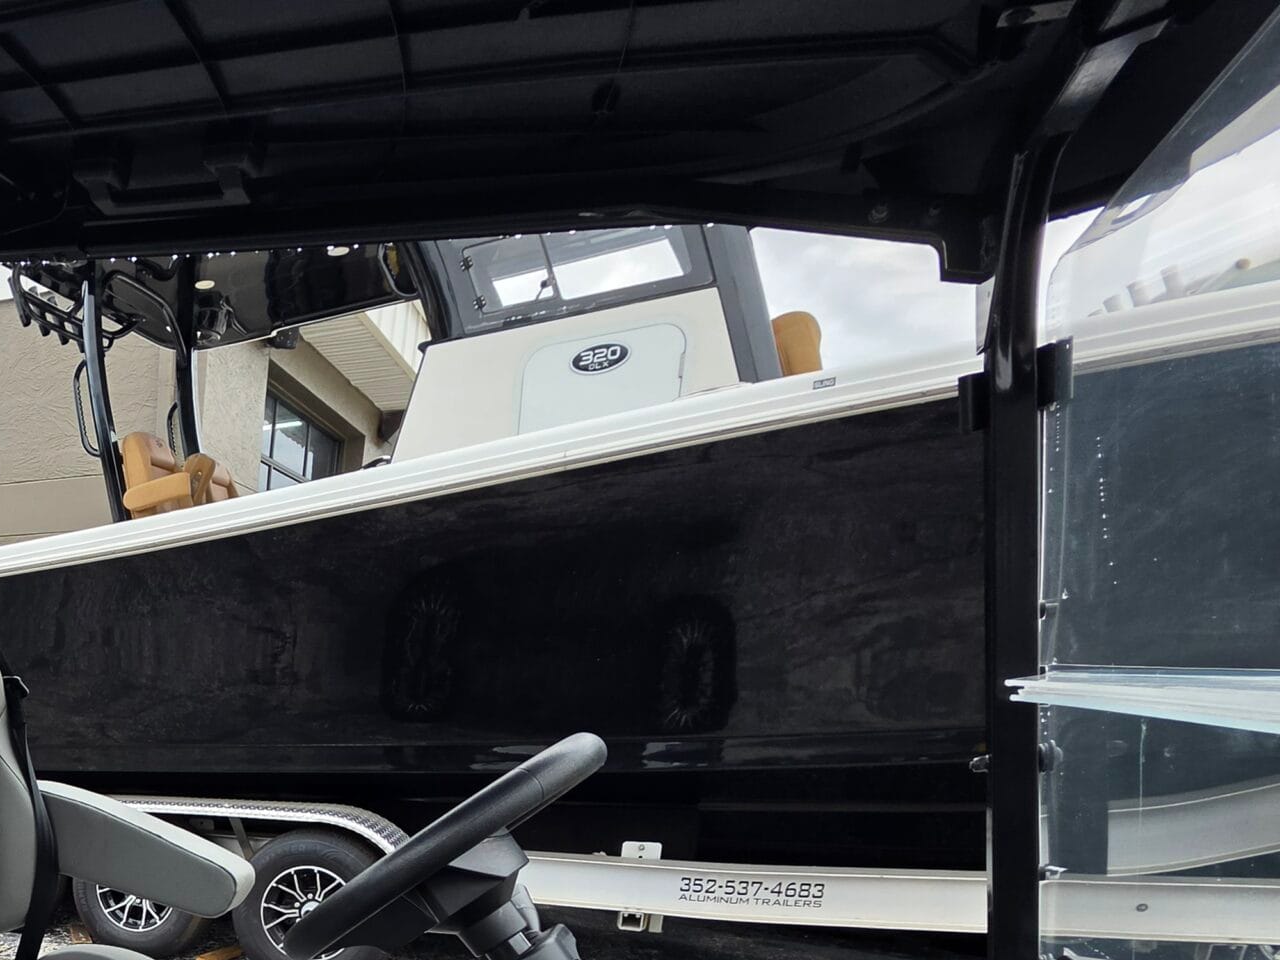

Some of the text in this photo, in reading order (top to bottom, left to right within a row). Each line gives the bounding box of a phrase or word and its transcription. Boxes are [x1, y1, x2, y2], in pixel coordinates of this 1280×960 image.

[578, 346, 621, 366] 320
[588, 361, 609, 370] DLX
[679, 876, 825, 899] 352-537-4683
[678, 893, 822, 908] ALUMINUM TRAILERS
